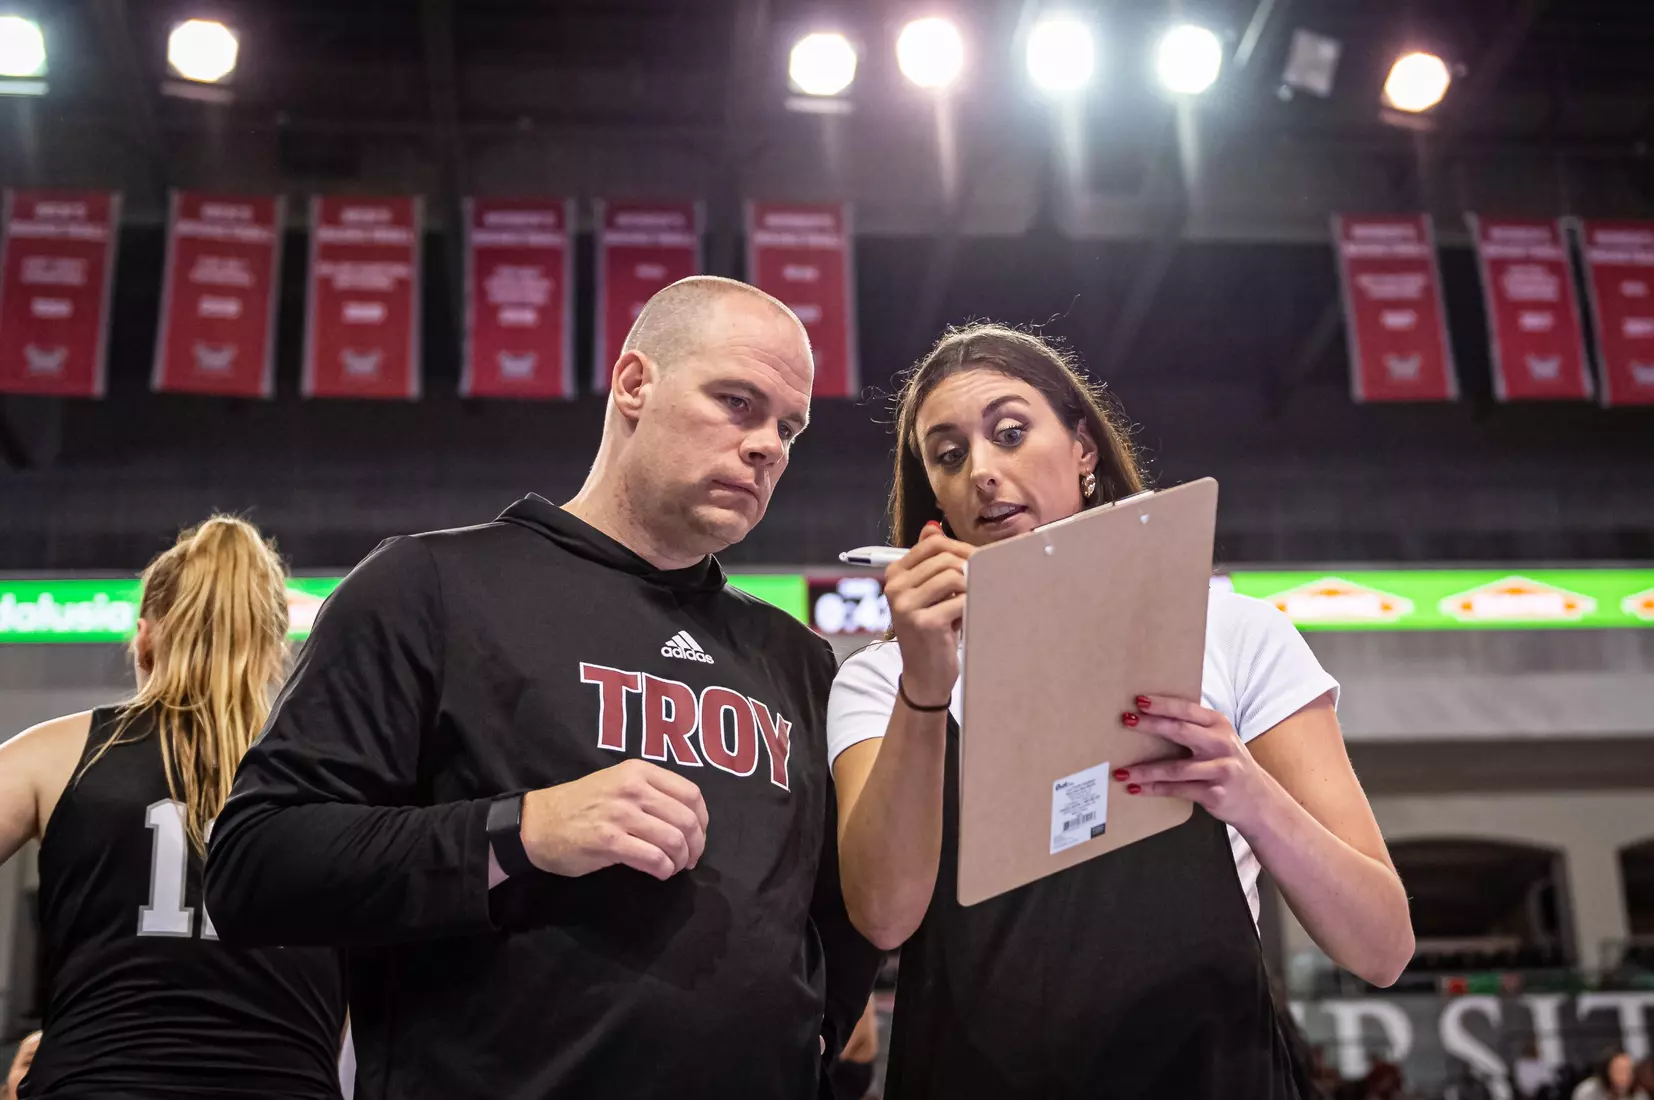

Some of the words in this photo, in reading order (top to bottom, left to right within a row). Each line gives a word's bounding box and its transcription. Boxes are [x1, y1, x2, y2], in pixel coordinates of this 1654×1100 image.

[661, 645, 715, 665] adidas
[579, 661, 792, 791] TROY
[137, 798, 220, 941] 1
